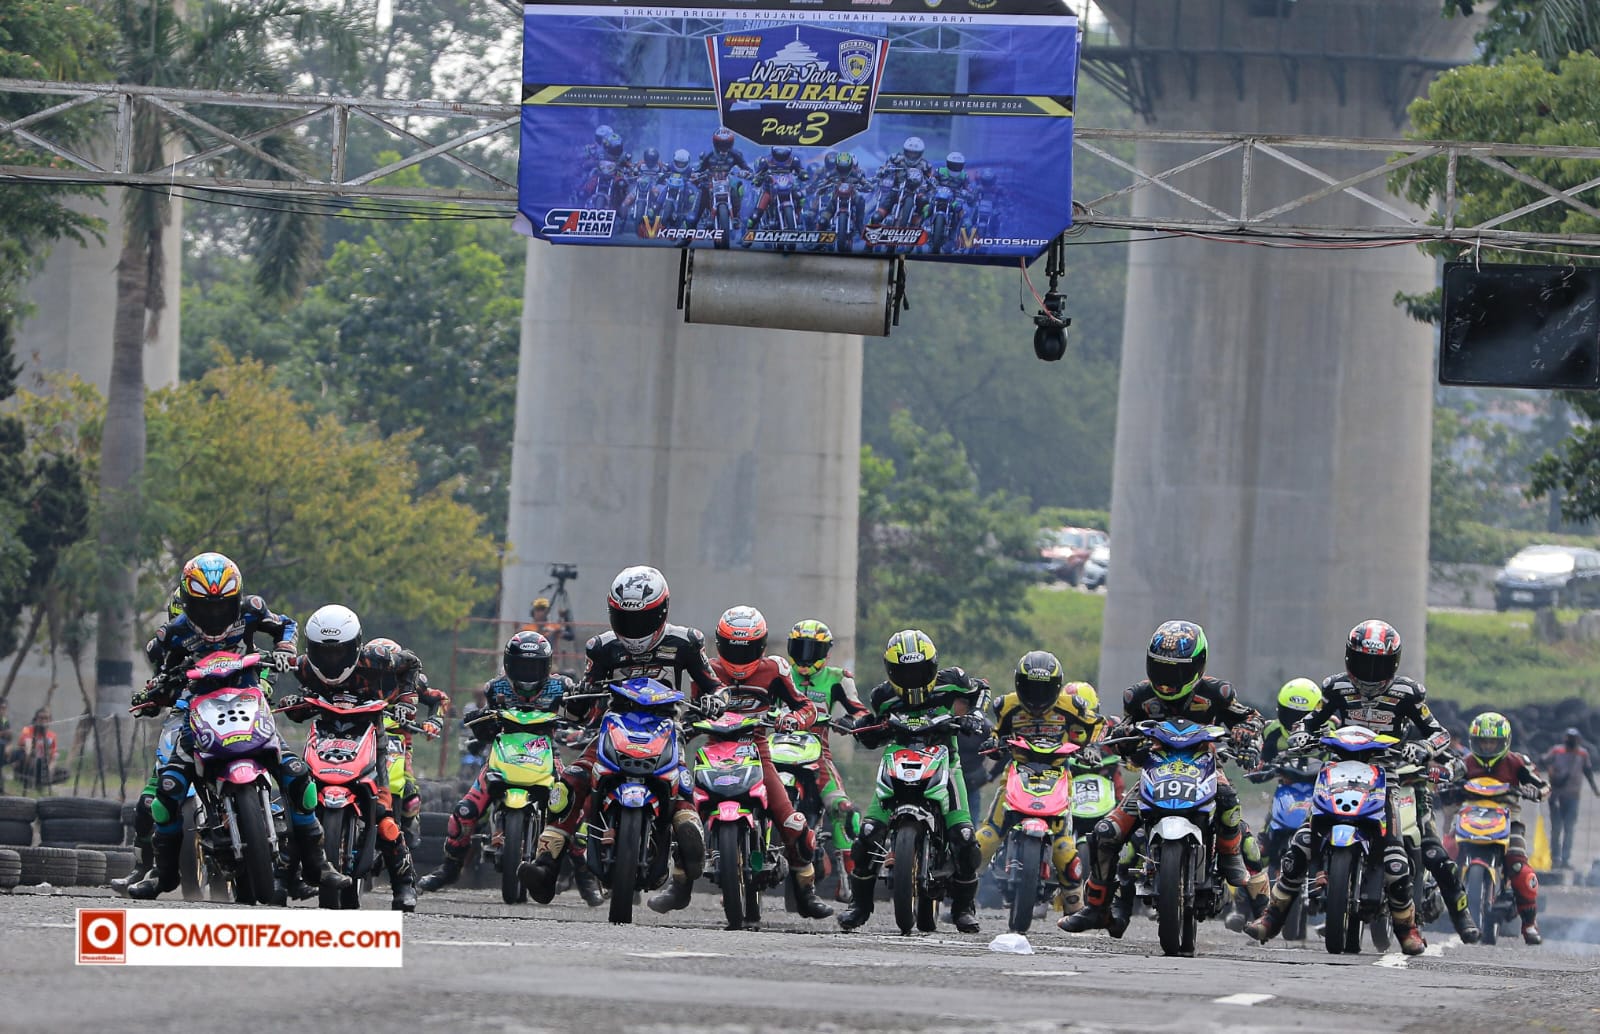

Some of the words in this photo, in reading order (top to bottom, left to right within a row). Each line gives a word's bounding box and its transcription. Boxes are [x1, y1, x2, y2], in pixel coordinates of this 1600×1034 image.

[623, 9, 676, 17] SIRKUIT
[683, 10, 727, 18] BRIGIF
[755, 12, 805, 20] KUJANG
[828, 13, 874, 21] CIMAHI
[751, 61, 792, 82] West
[798, 62, 839, 83] Java
[725, 82, 800, 100] ROAD
[801, 83, 870, 101] RACE
[785, 101, 863, 112] Championship
[892, 99, 921, 107] SABTU
[943, 100, 998, 109] SEPTEMBER
[761, 117, 801, 137] Part
[799, 111, 830, 145] 3
[579, 211, 614, 222] RACE
[577, 222, 612, 233] TEAM
[657, 228, 725, 239] KARAOKE
[887, 235, 918, 243] SPEED
[973, 238, 1049, 246] MOTOSHOP
[1155, 780, 1196, 799] 197
